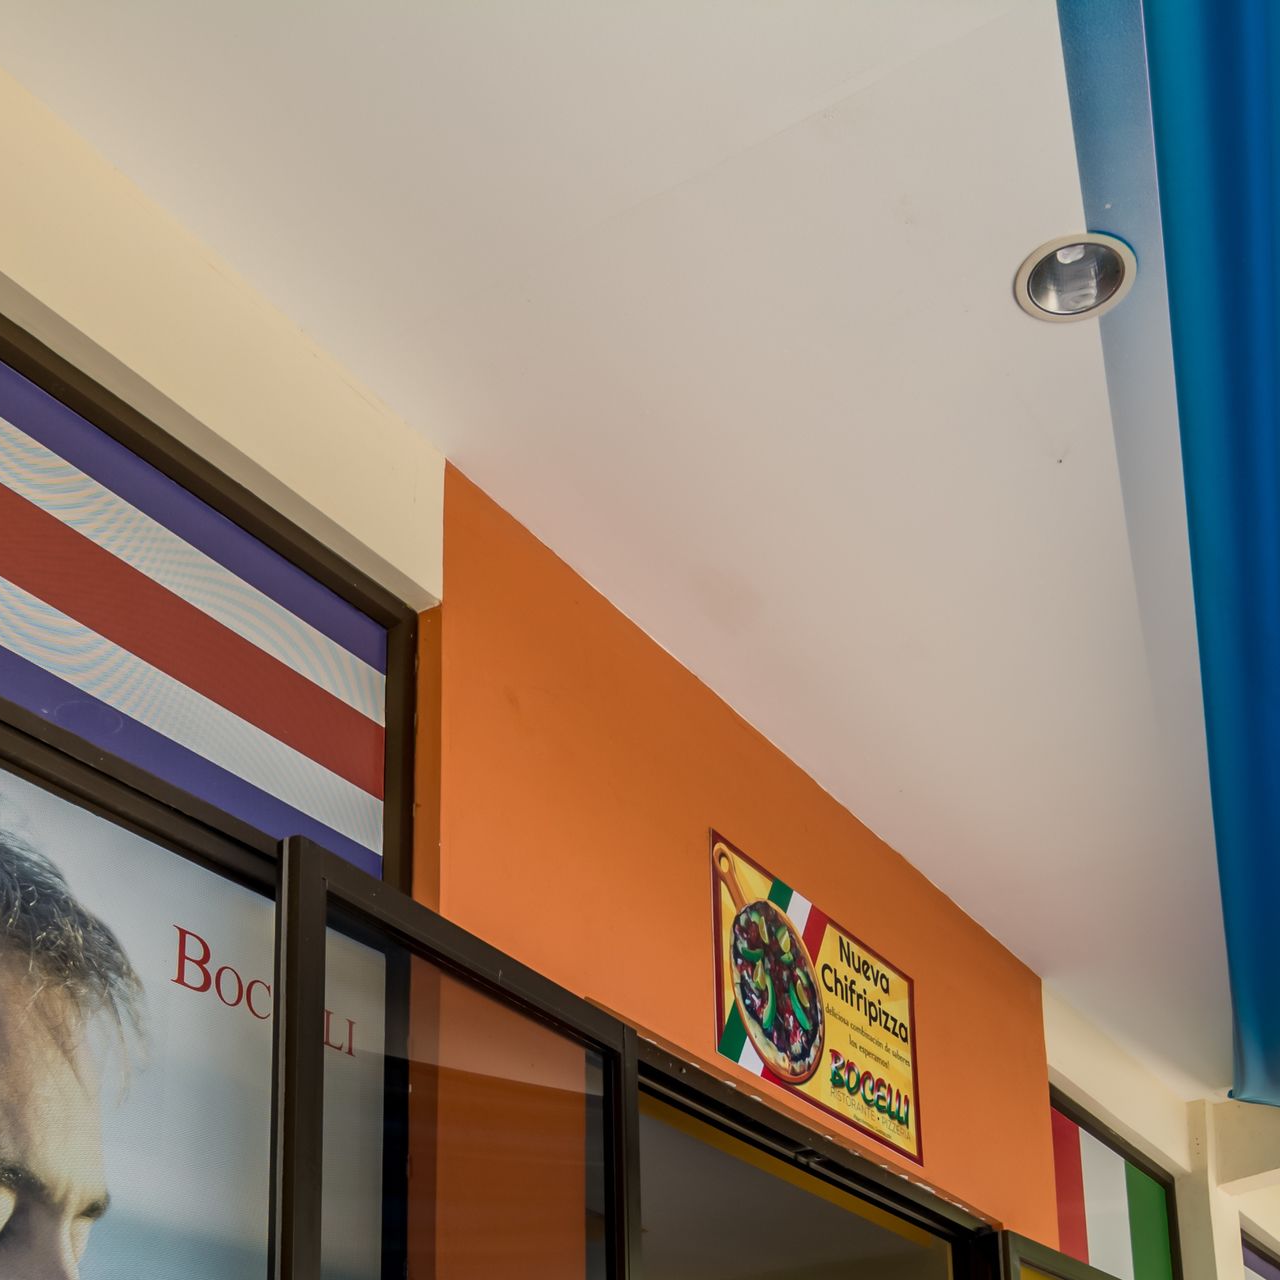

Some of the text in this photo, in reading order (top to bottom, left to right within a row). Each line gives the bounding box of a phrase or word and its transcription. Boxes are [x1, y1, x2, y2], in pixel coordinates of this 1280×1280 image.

[171, 924, 356, 1057] BOCLI
[821, 963, 909, 1045] Chifripizza
[839, 935, 890, 995] Nueva
[830, 1049, 909, 1129] BOCELLI
[831, 1087, 876, 1121] RISTORANTE
